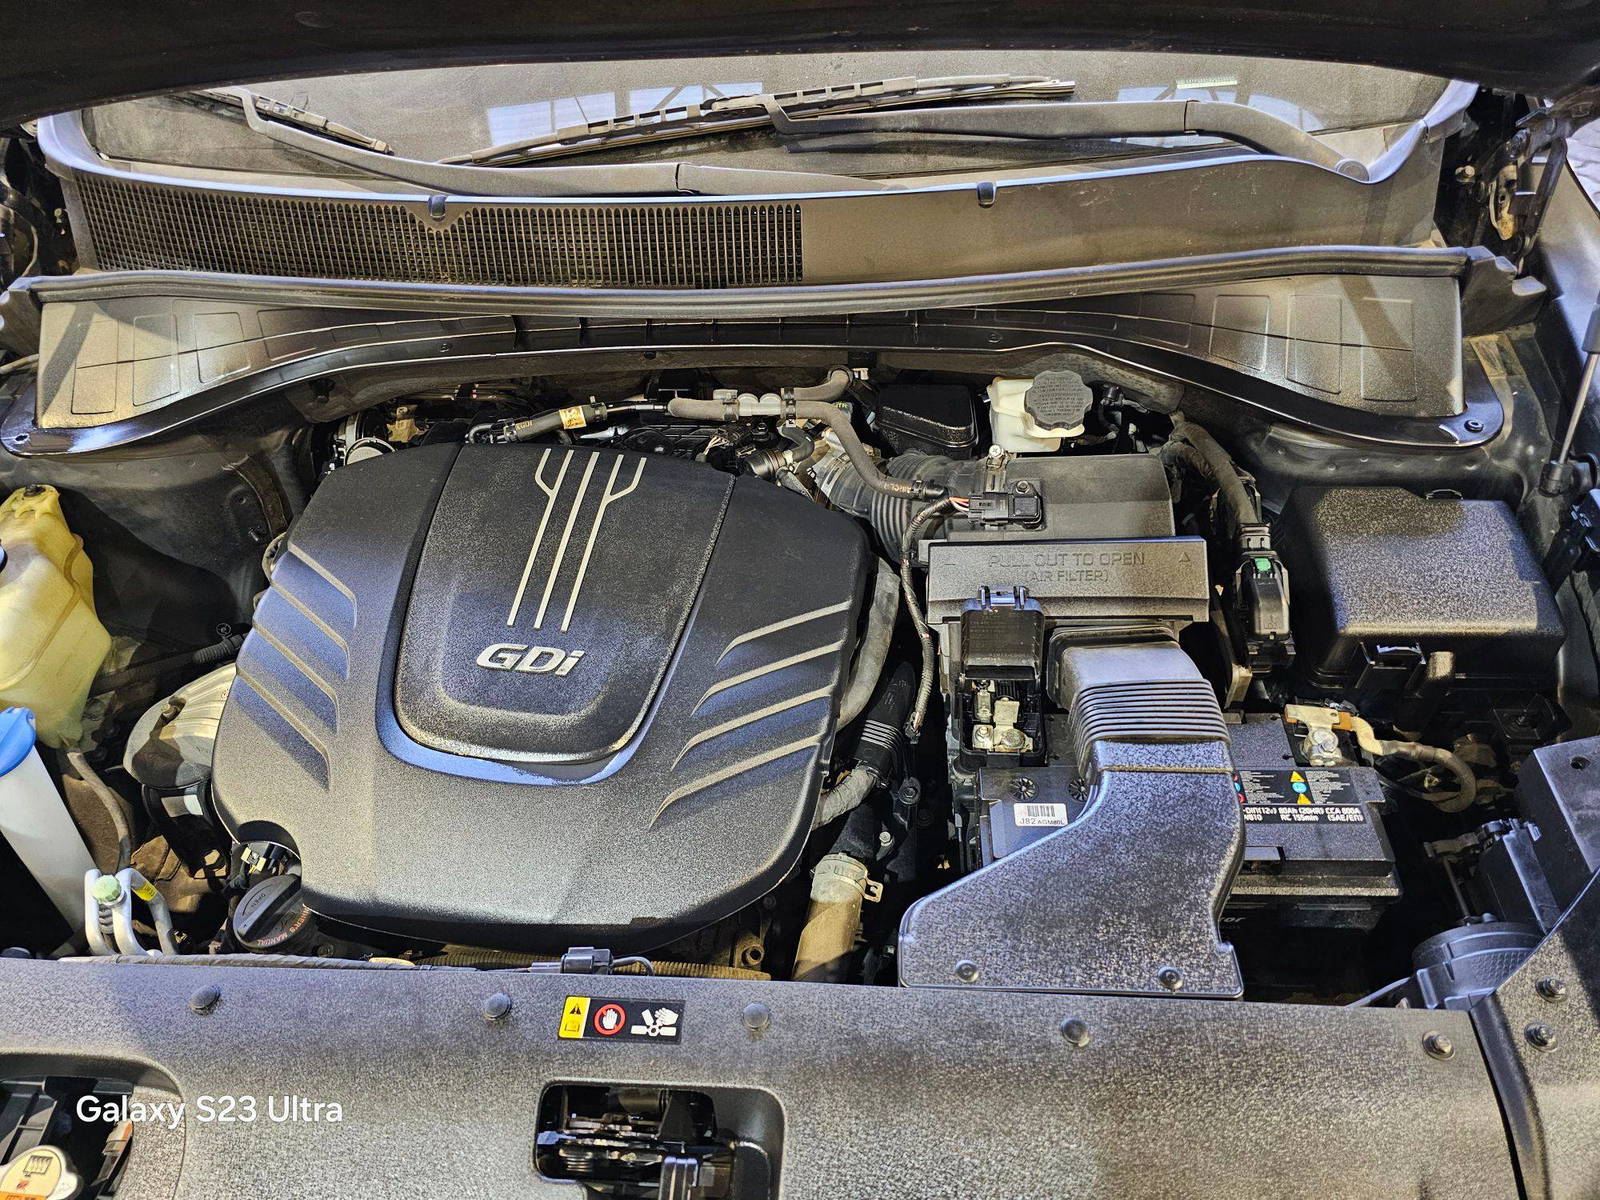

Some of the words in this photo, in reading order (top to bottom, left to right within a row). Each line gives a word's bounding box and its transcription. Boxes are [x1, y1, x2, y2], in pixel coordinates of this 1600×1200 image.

[988, 554, 1030, 568] PULL
[1033, 553, 1067, 568] OUT
[1071, 552, 1094, 567] TO
[1101, 552, 1145, 567] OPEN
[1056, 569, 1109, 583] FILTER)
[476, 643, 585, 676] GDi
[1325, 807, 1341, 815] CCA
